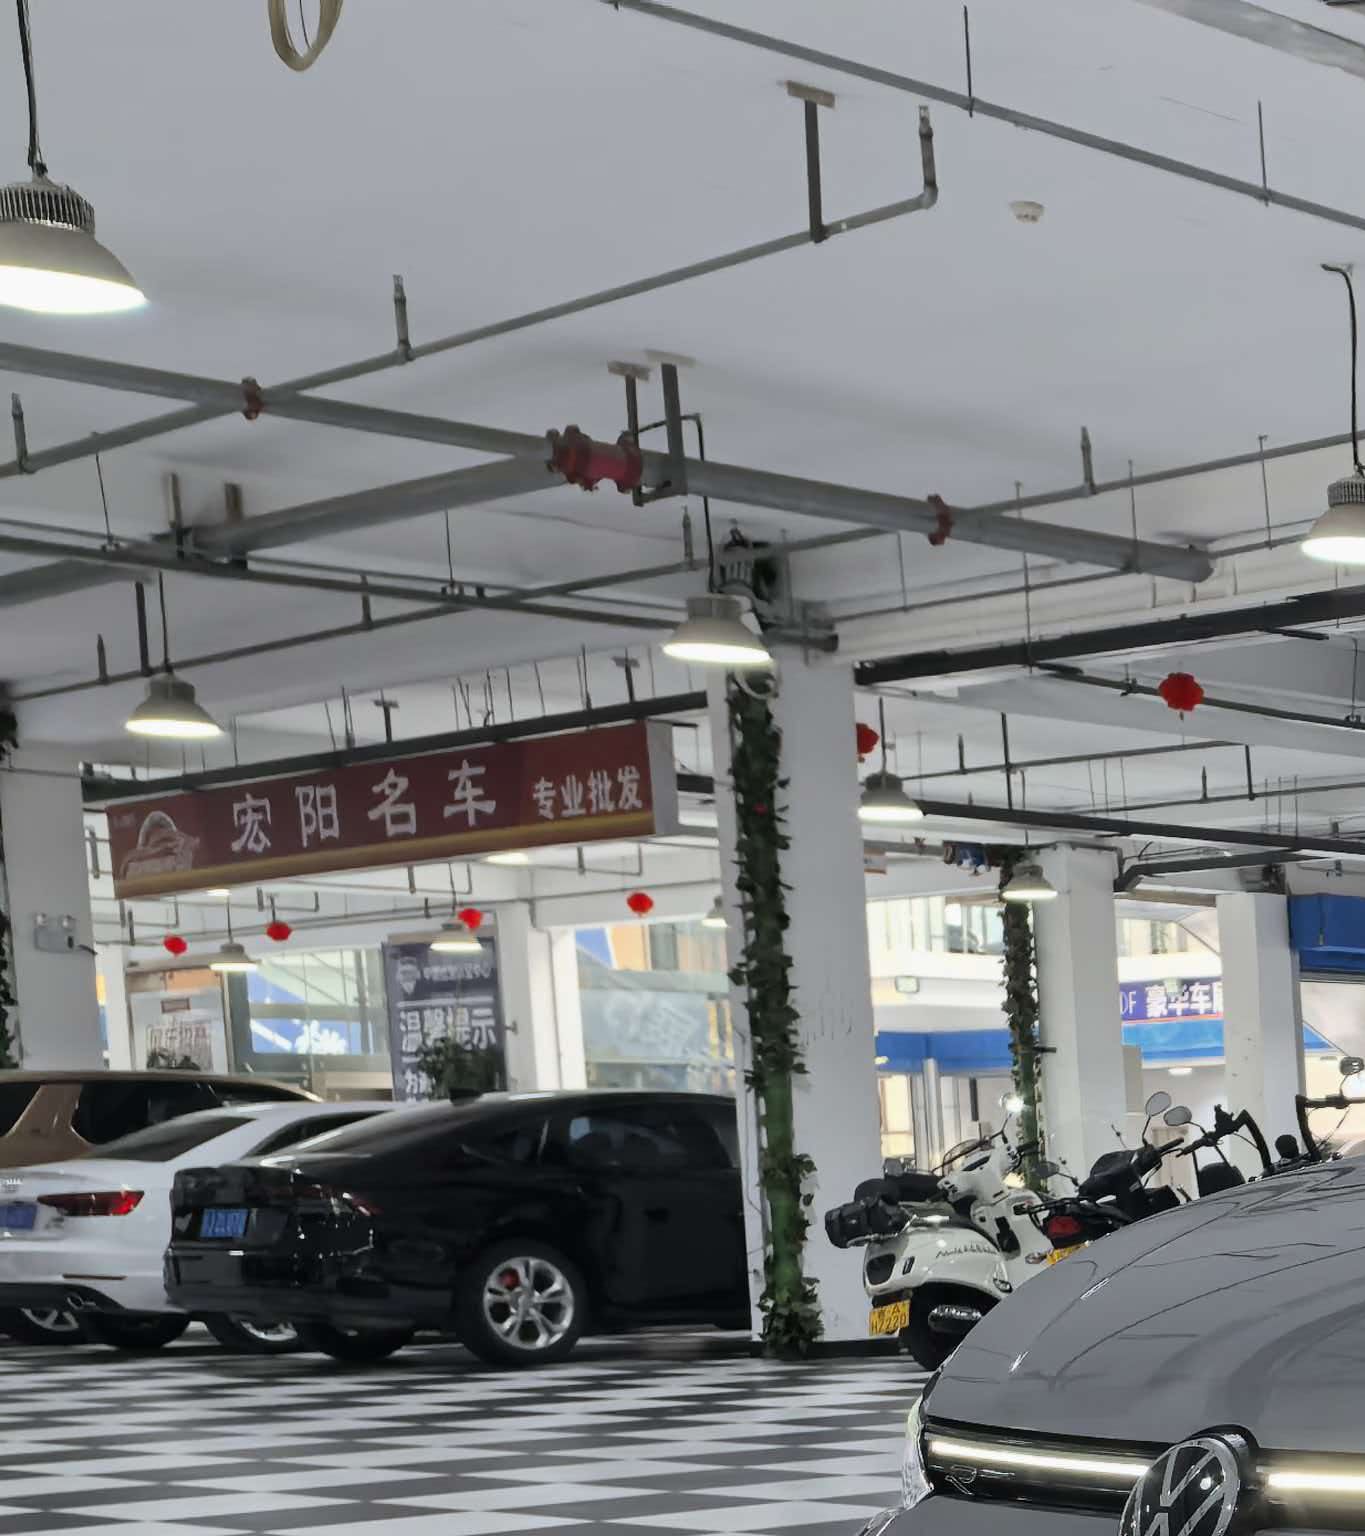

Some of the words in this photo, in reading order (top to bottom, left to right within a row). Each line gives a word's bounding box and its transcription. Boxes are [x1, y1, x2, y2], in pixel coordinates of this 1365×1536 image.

[231, 759, 496, 854] 宏阳名车
[532, 765, 643, 820] 专业批发
[400, 1006, 497, 1053] 温馨提示
